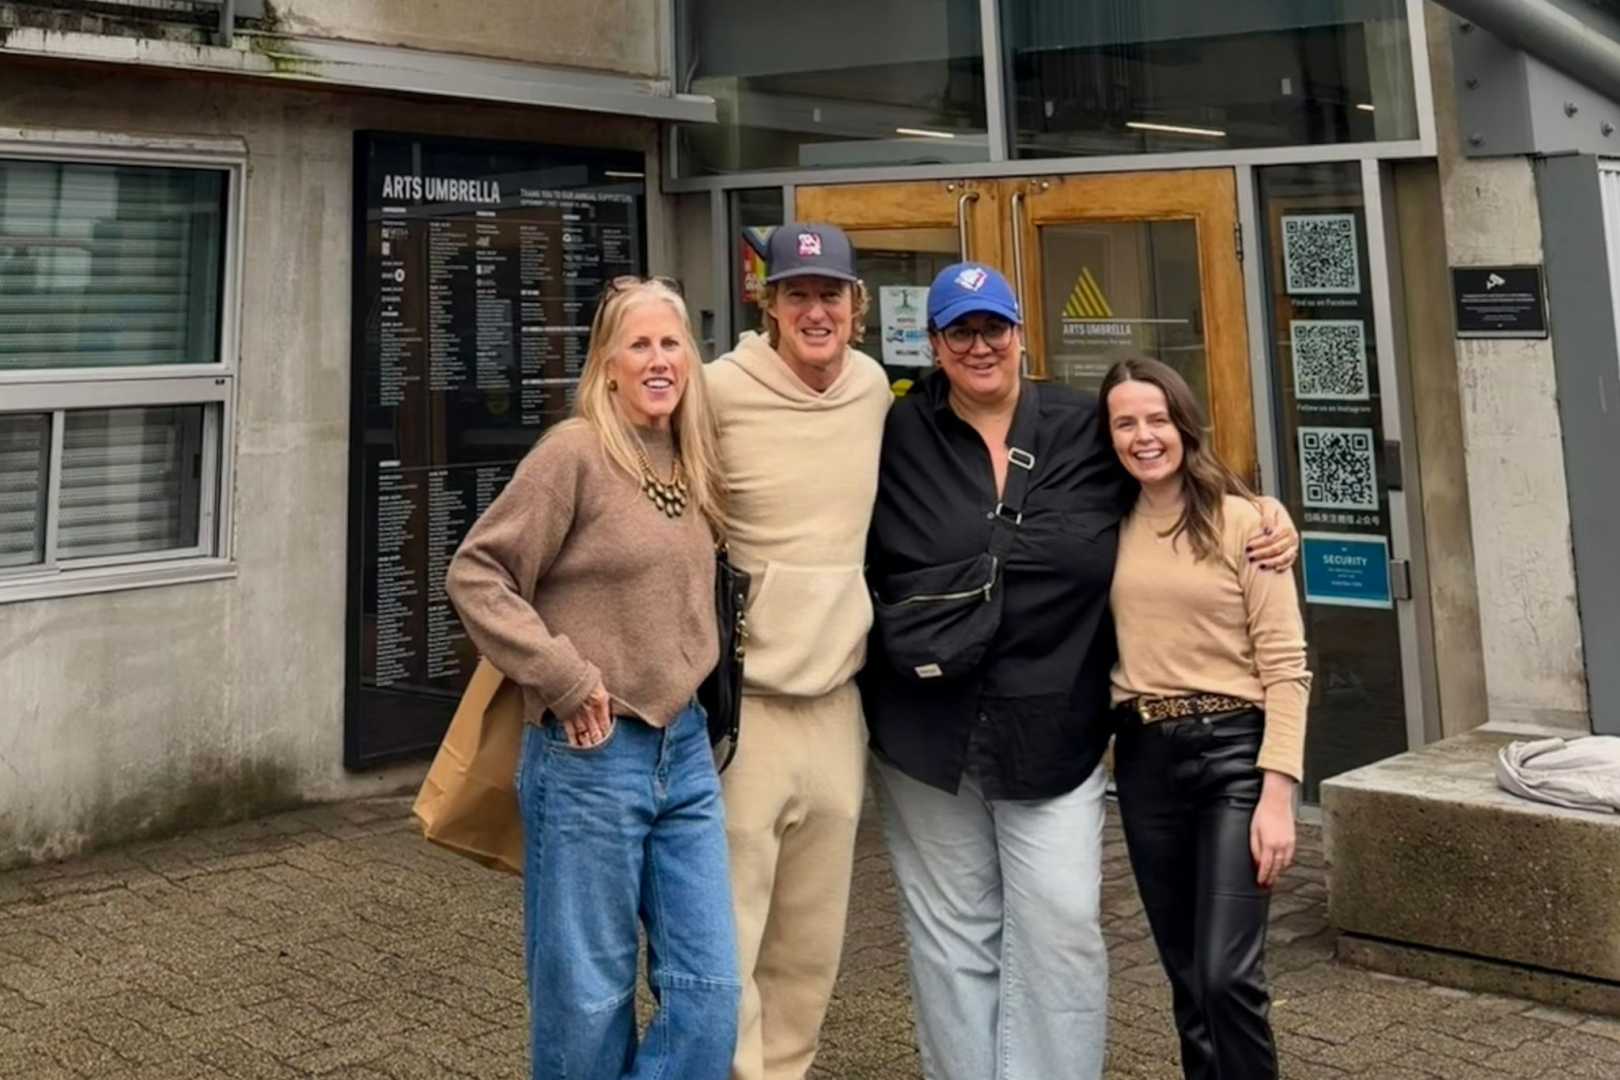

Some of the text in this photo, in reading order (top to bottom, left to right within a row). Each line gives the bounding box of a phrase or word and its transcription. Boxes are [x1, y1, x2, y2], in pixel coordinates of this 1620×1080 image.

[382, 174, 501, 203] ARTS UMBRELLA
[1063, 324, 1131, 337] ARTS UMBRELLA
[1322, 553, 1368, 566] SECURITY
